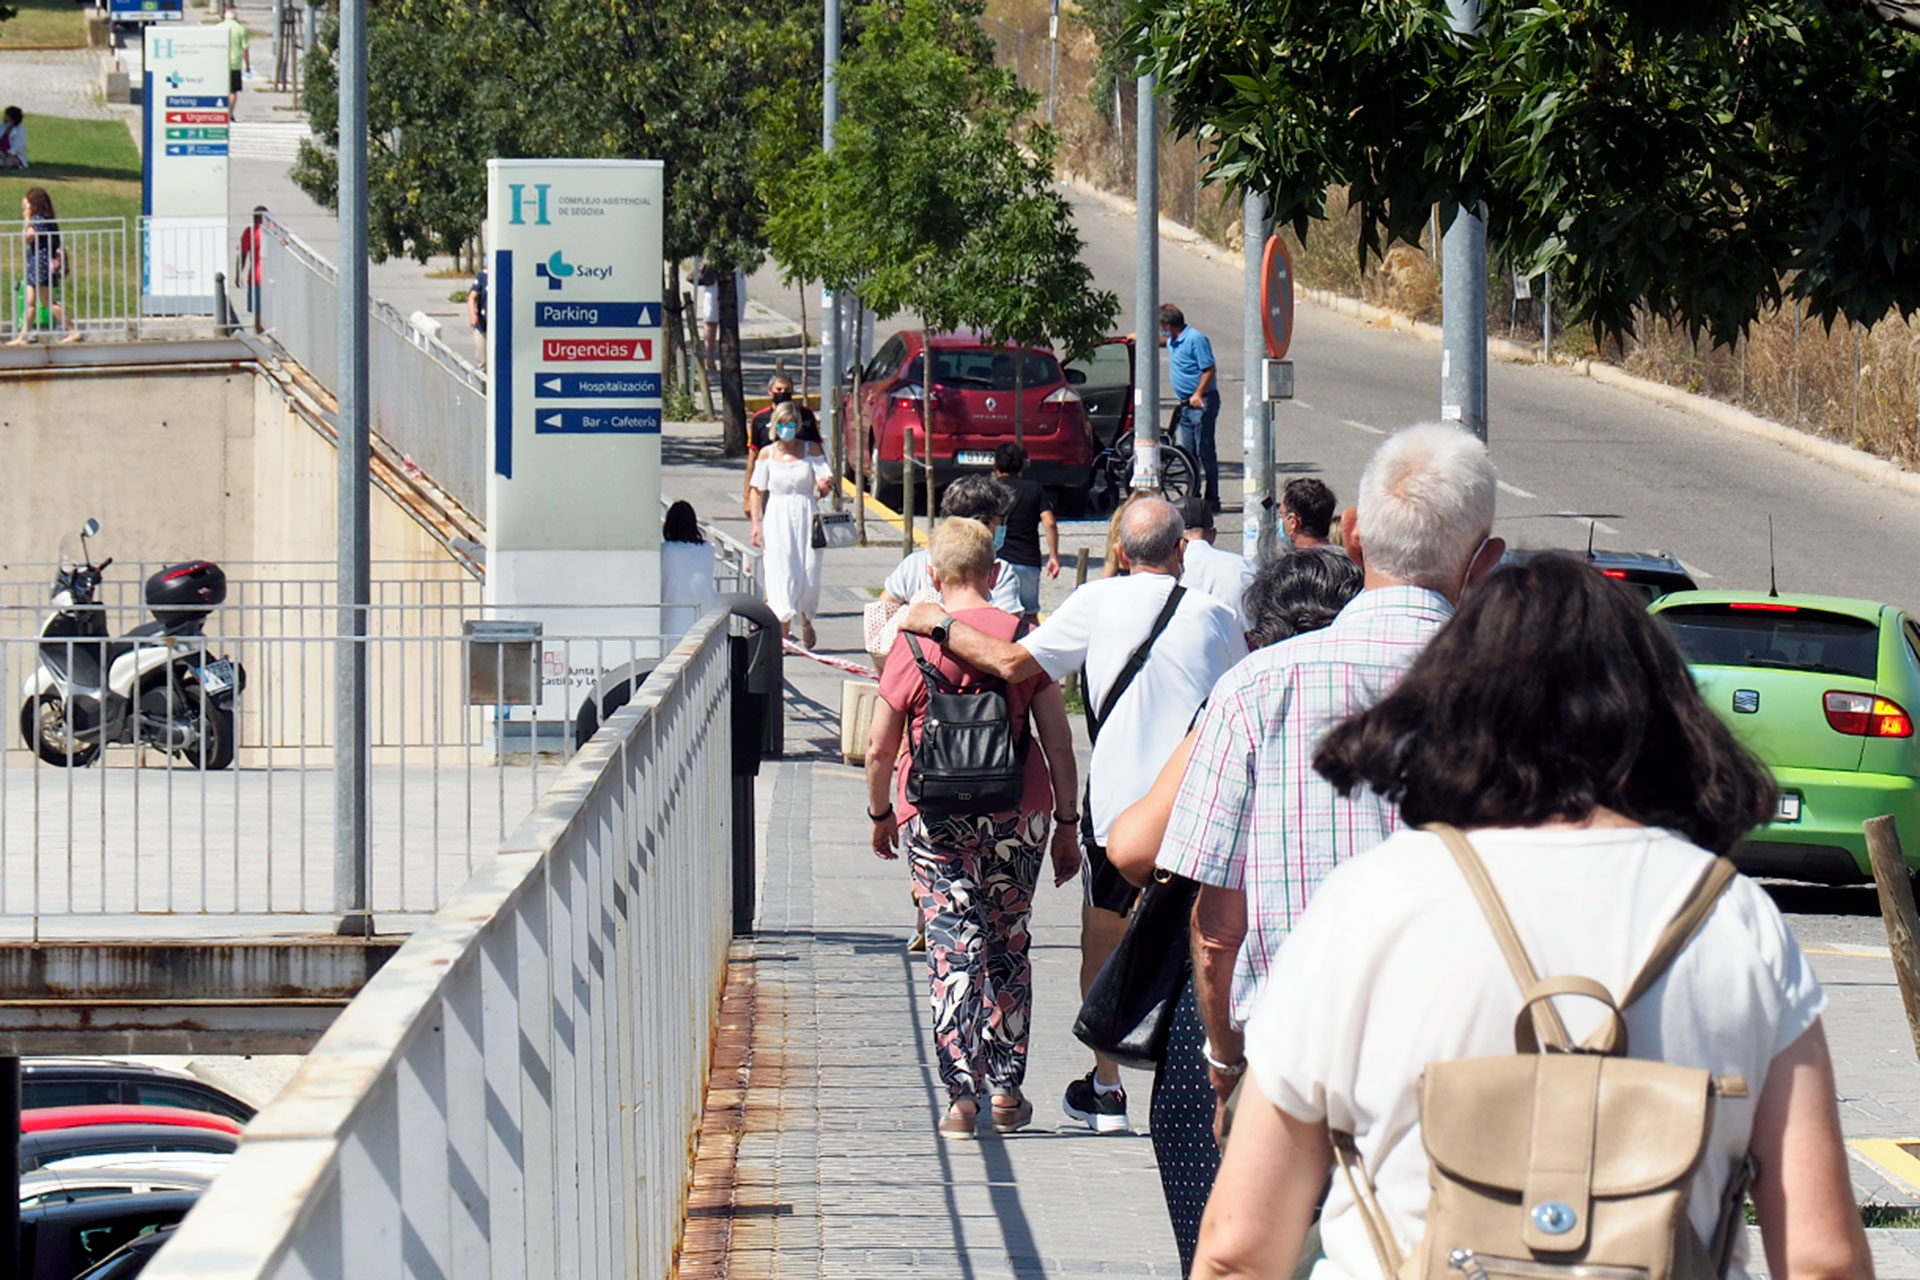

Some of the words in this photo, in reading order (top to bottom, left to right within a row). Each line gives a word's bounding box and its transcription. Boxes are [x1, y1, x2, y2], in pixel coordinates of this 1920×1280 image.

[153, 39, 173, 59] H
[508, 184, 552, 225] H
[558, 196, 601, 206] COMPLEJO
[603, 197, 652, 206] ASISTENCIAL
[558, 207, 569, 216] DE
[571, 207, 605, 216] SEGOVIA
[577, 265, 613, 280] Sacyl
[544, 306, 598, 324] Parking
[548, 342, 629, 360] Urgencias
[579, 380, 655, 393] Hospitalización
[582, 416, 600, 427] Bar
[611, 416, 657, 427] Cafetería
